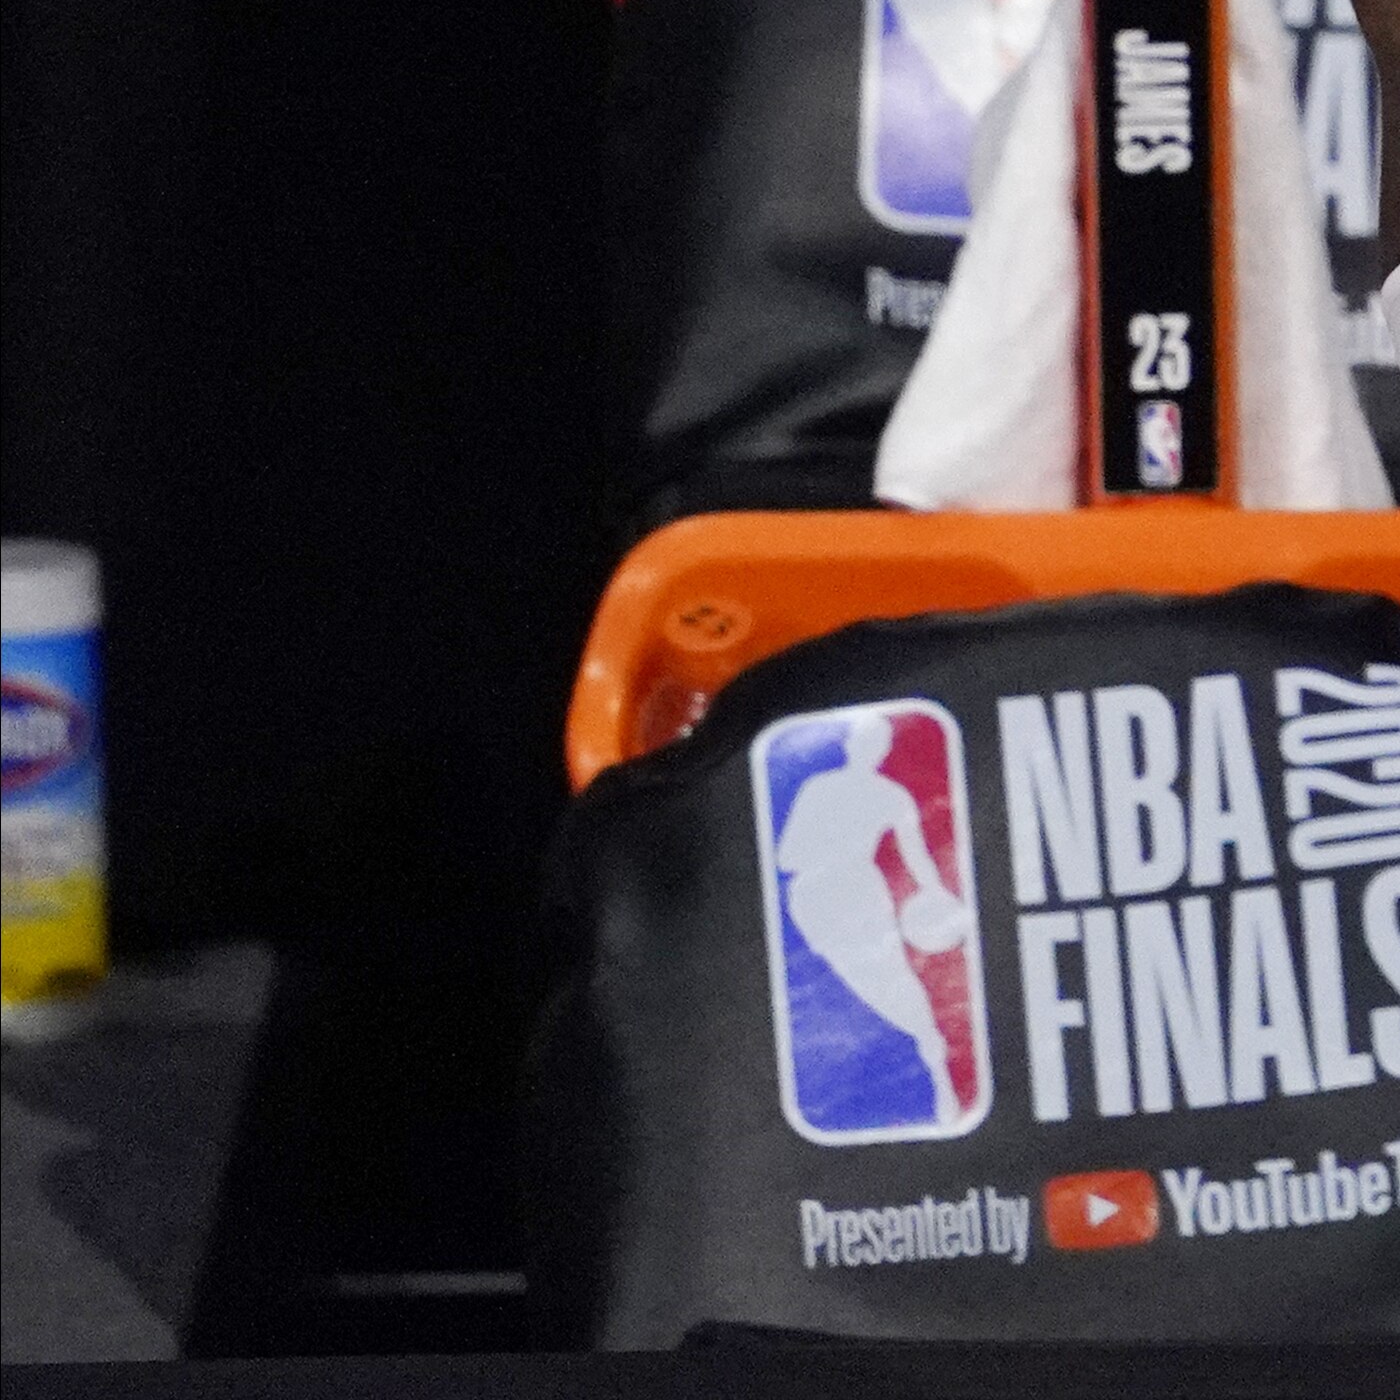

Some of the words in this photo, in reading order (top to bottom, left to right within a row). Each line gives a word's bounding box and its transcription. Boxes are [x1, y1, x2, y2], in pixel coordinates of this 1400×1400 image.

[1112, 27, 1194, 175] JAMES
[1127, 311, 1194, 393] 23
[997, 673, 1275, 905] NBA
[800, 1187, 983, 1269] Presented
[985, 1185, 1030, 1265] by
